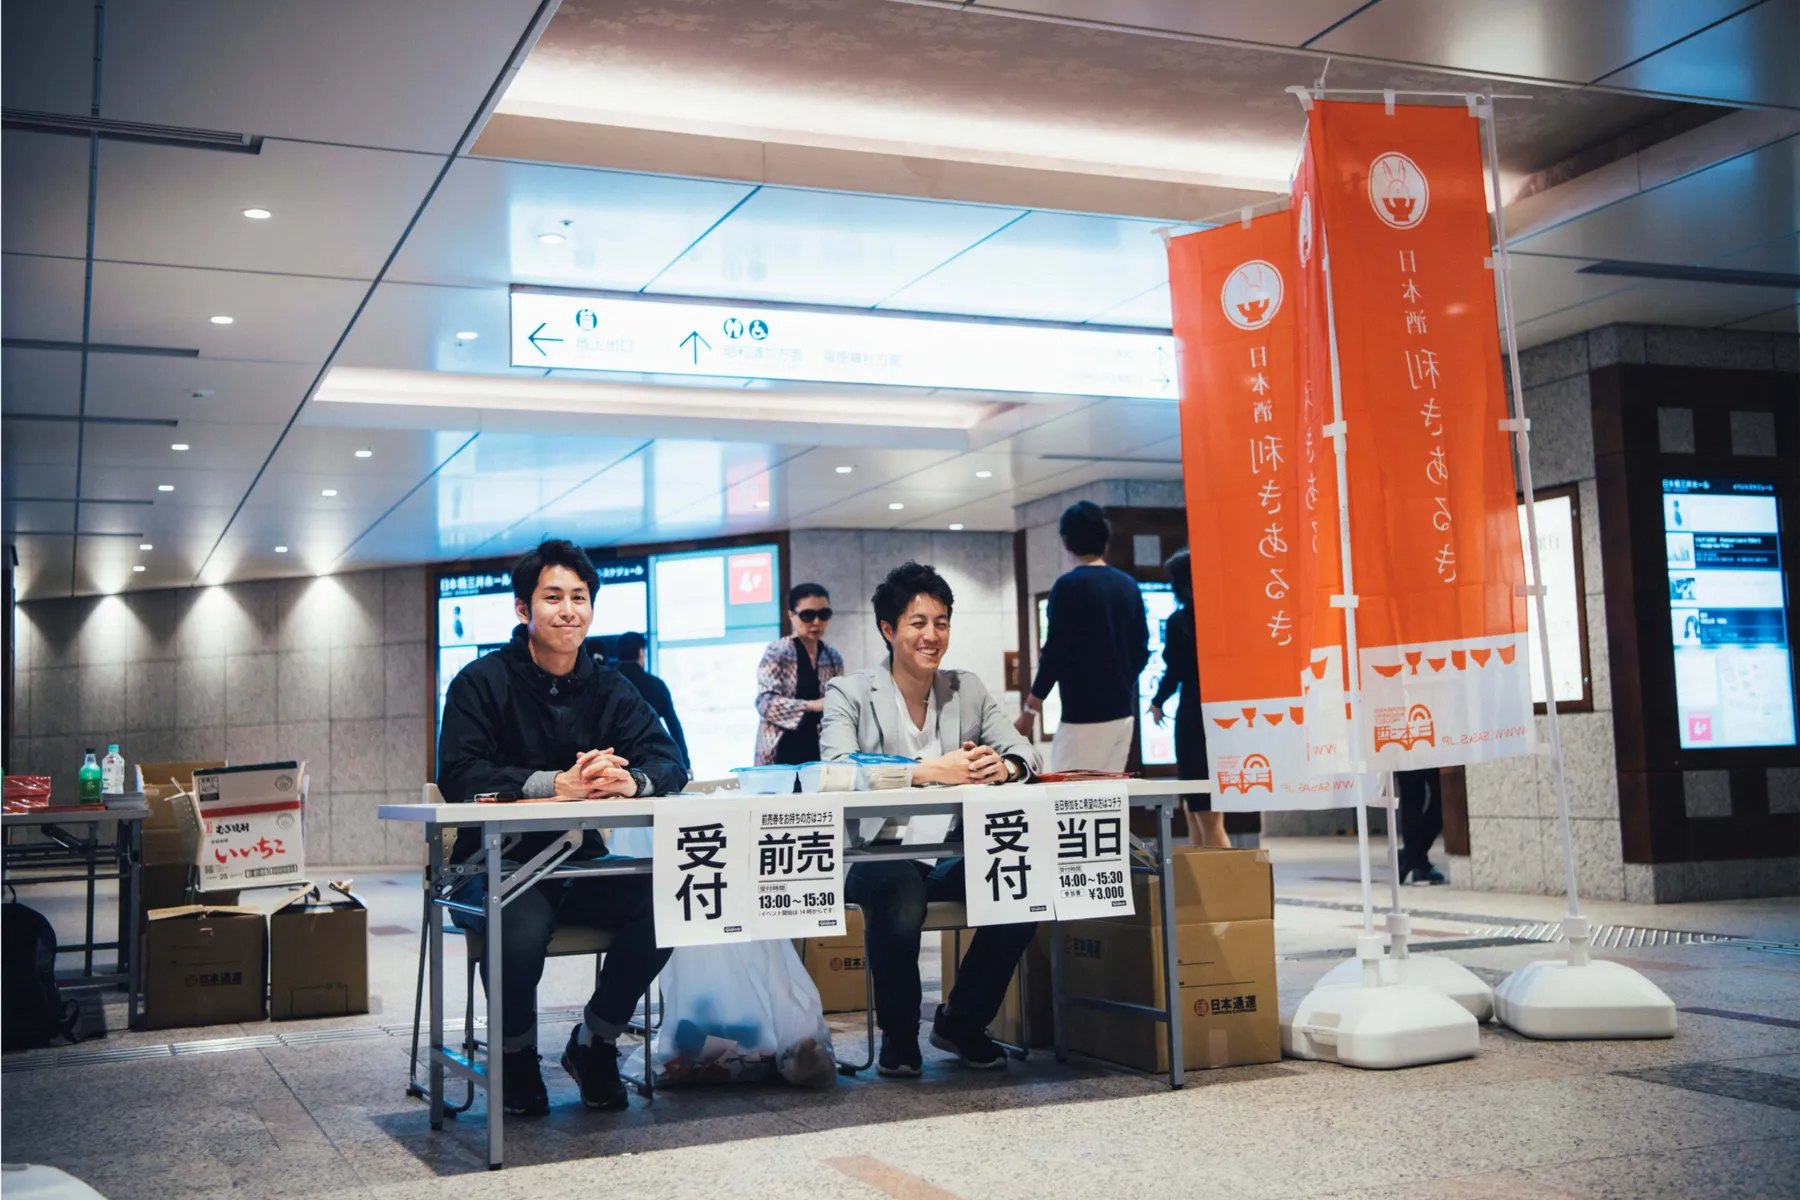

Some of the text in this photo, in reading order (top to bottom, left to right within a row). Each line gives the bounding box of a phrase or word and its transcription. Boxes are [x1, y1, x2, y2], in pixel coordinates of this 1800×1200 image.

[215, 836, 287, 865] いいちこ
[758, 831, 836, 876] 前売
[984, 809, 1032, 902] 受付
[1057, 817, 1122, 858] 当日
[675, 822, 728, 921] 受付
[1211, 996, 1256, 1010] 日本通運
